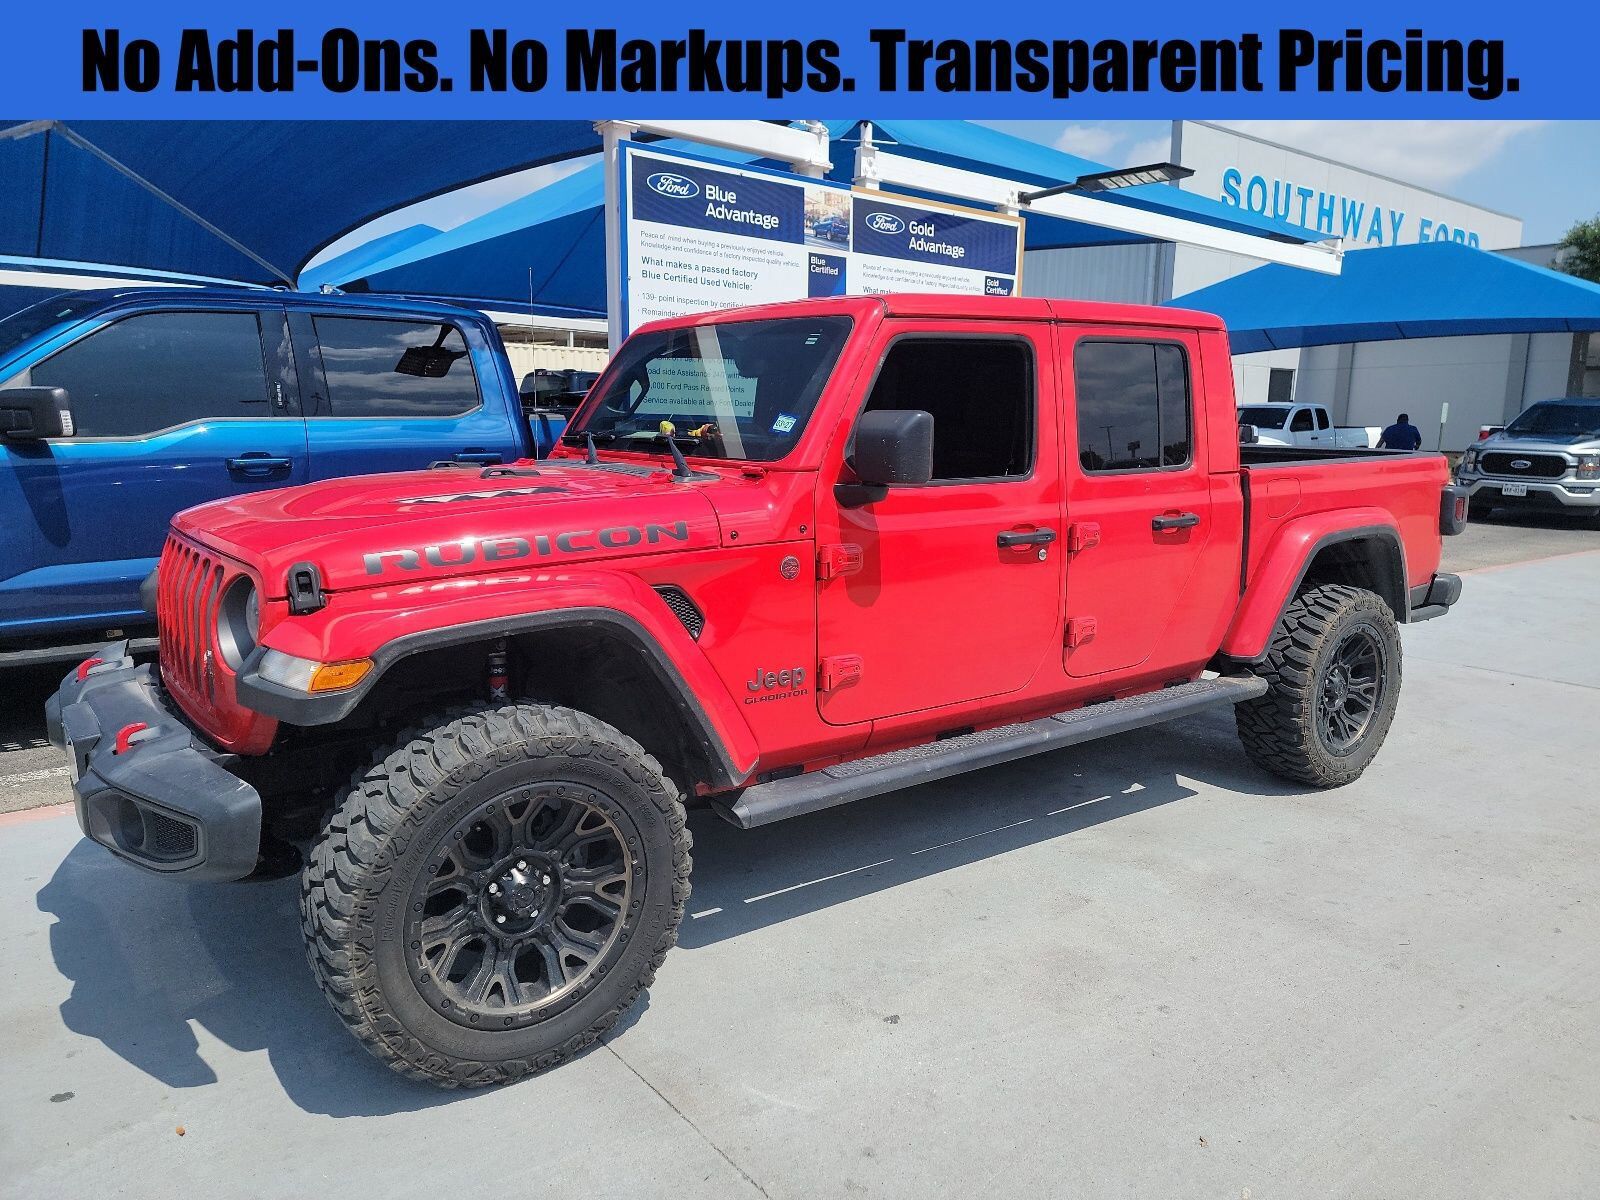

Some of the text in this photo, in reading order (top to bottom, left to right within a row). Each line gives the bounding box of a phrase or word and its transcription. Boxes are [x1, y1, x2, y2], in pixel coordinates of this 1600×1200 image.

[655, 174, 691, 196] Ford
[705, 184, 737, 204] Blue
[1221, 167, 1405, 247] SOUTHWAY
[705, 202, 780, 230] Advantage
[872, 214, 899, 232] Ford
[909, 221, 935, 237] Gold
[640, 230, 659, 239] Peace
[698, 239, 716, 248] buying
[640, 240, 672, 251] Knowledge
[684, 247, 712, 256] confidence
[908, 237, 965, 259] Advantage
[641, 255, 664, 267] What
[666, 260, 693, 270] makes
[702, 265, 730, 276] passed
[732, 267, 759, 280] factory
[810, 256, 826, 267] Blue
[810, 264, 839, 276] Certified
[641, 269, 753, 291] Blue Certified Used Vehicle:
[986, 278, 1000, 287] Gold
[862, 285, 879, 294] What
[985, 286, 1008, 296] Certified
[658, 294, 675, 303] point
[711, 300, 718, 309] by
[647, 367, 661, 375] oad
[667, 382, 682, 391] Ford
[683, 383, 699, 391] Pass
[643, 396, 668, 404] Service
[669, 397, 698, 405] available
[362, 521, 689, 576] RUBICON
[747, 667, 807, 691] Jeep
[744, 688, 808, 705] GLADIATOR
